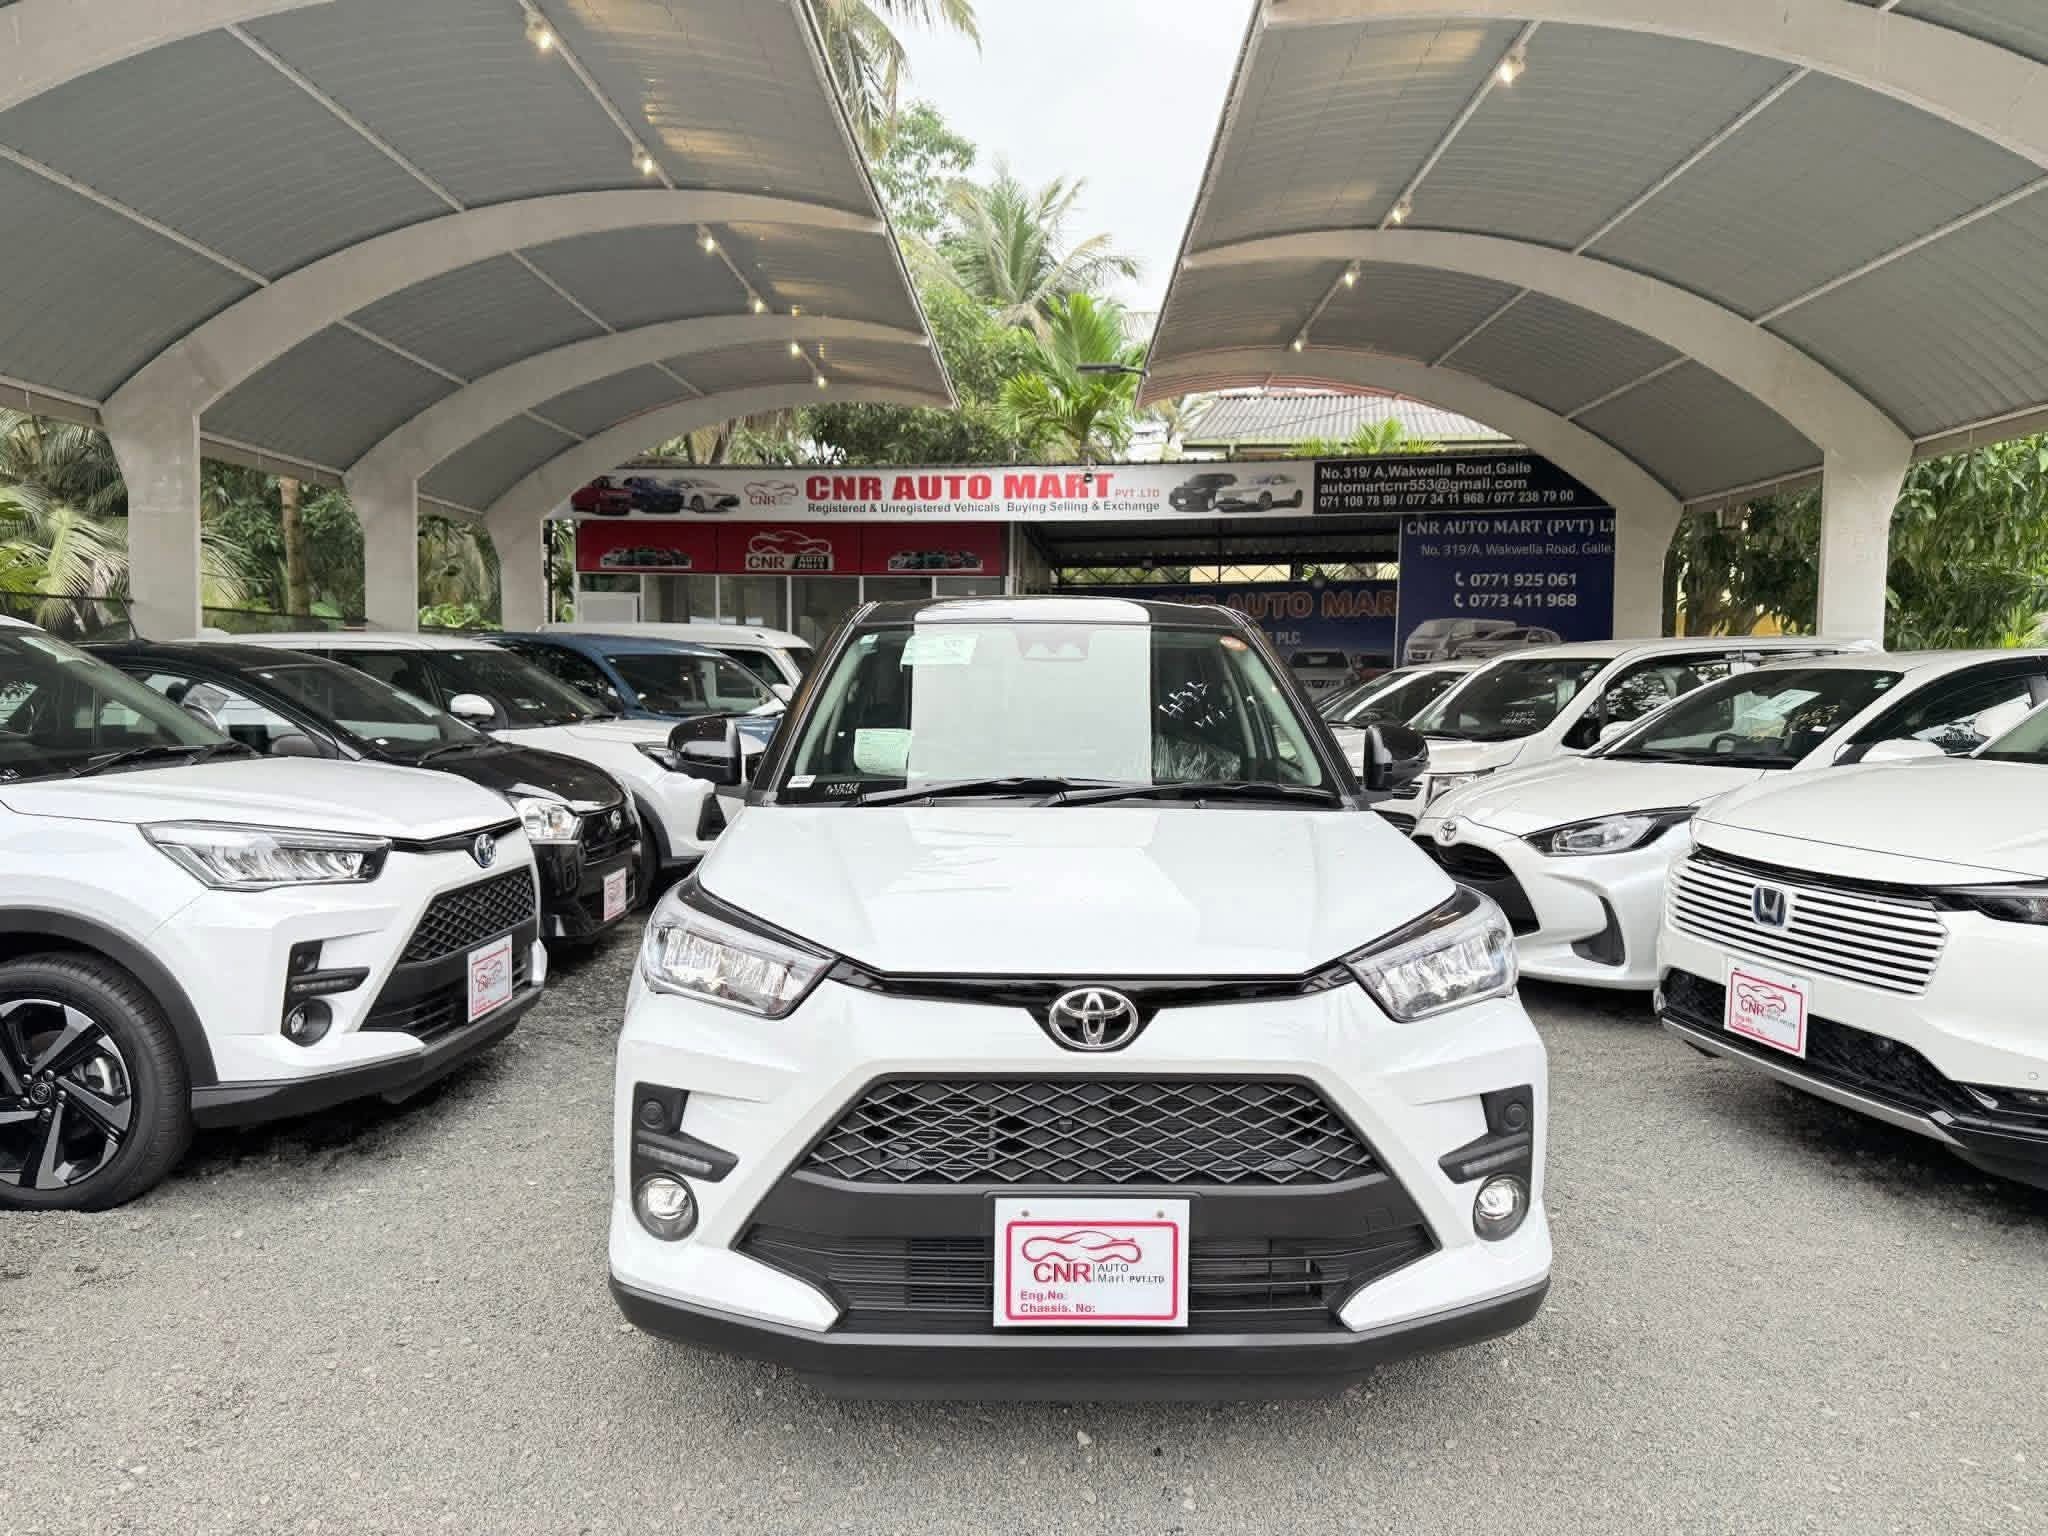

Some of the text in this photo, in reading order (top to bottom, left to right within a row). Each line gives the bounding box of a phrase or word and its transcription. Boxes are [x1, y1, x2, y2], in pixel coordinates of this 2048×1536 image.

[806, 475, 881, 501] CNR
[893, 475, 992, 500] AUTO
[1003, 474, 1114, 499] MART
[1406, 494, 1427, 505] 077
[807, 503, 866, 515] Registered
[869, 503, 877, 513] &
[880, 503, 951, 515] Unregistered
[954, 502, 1000, 512] Vehicals
[1007, 502, 1046, 513] Buying
[1091, 501, 1100, 511] &
[1103, 500, 1160, 512] Exchange
[1407, 521, 1440, 535] CNR
[1443, 521, 1489, 534] AUTO
[1493, 520, 1542, 533] MART
[1547, 519, 1594, 536] (PVT)
[1486, 544, 1543, 554] Wakwella
[748, 556, 785, 569] CNR
[1470, 573, 1577, 586] 0771 925 061
[1469, 594, 1577, 607] 0773 411 968
[1033, 1263, 1129, 1283] CNR AUTO
[1075, 1304, 1096, 1313] No:
